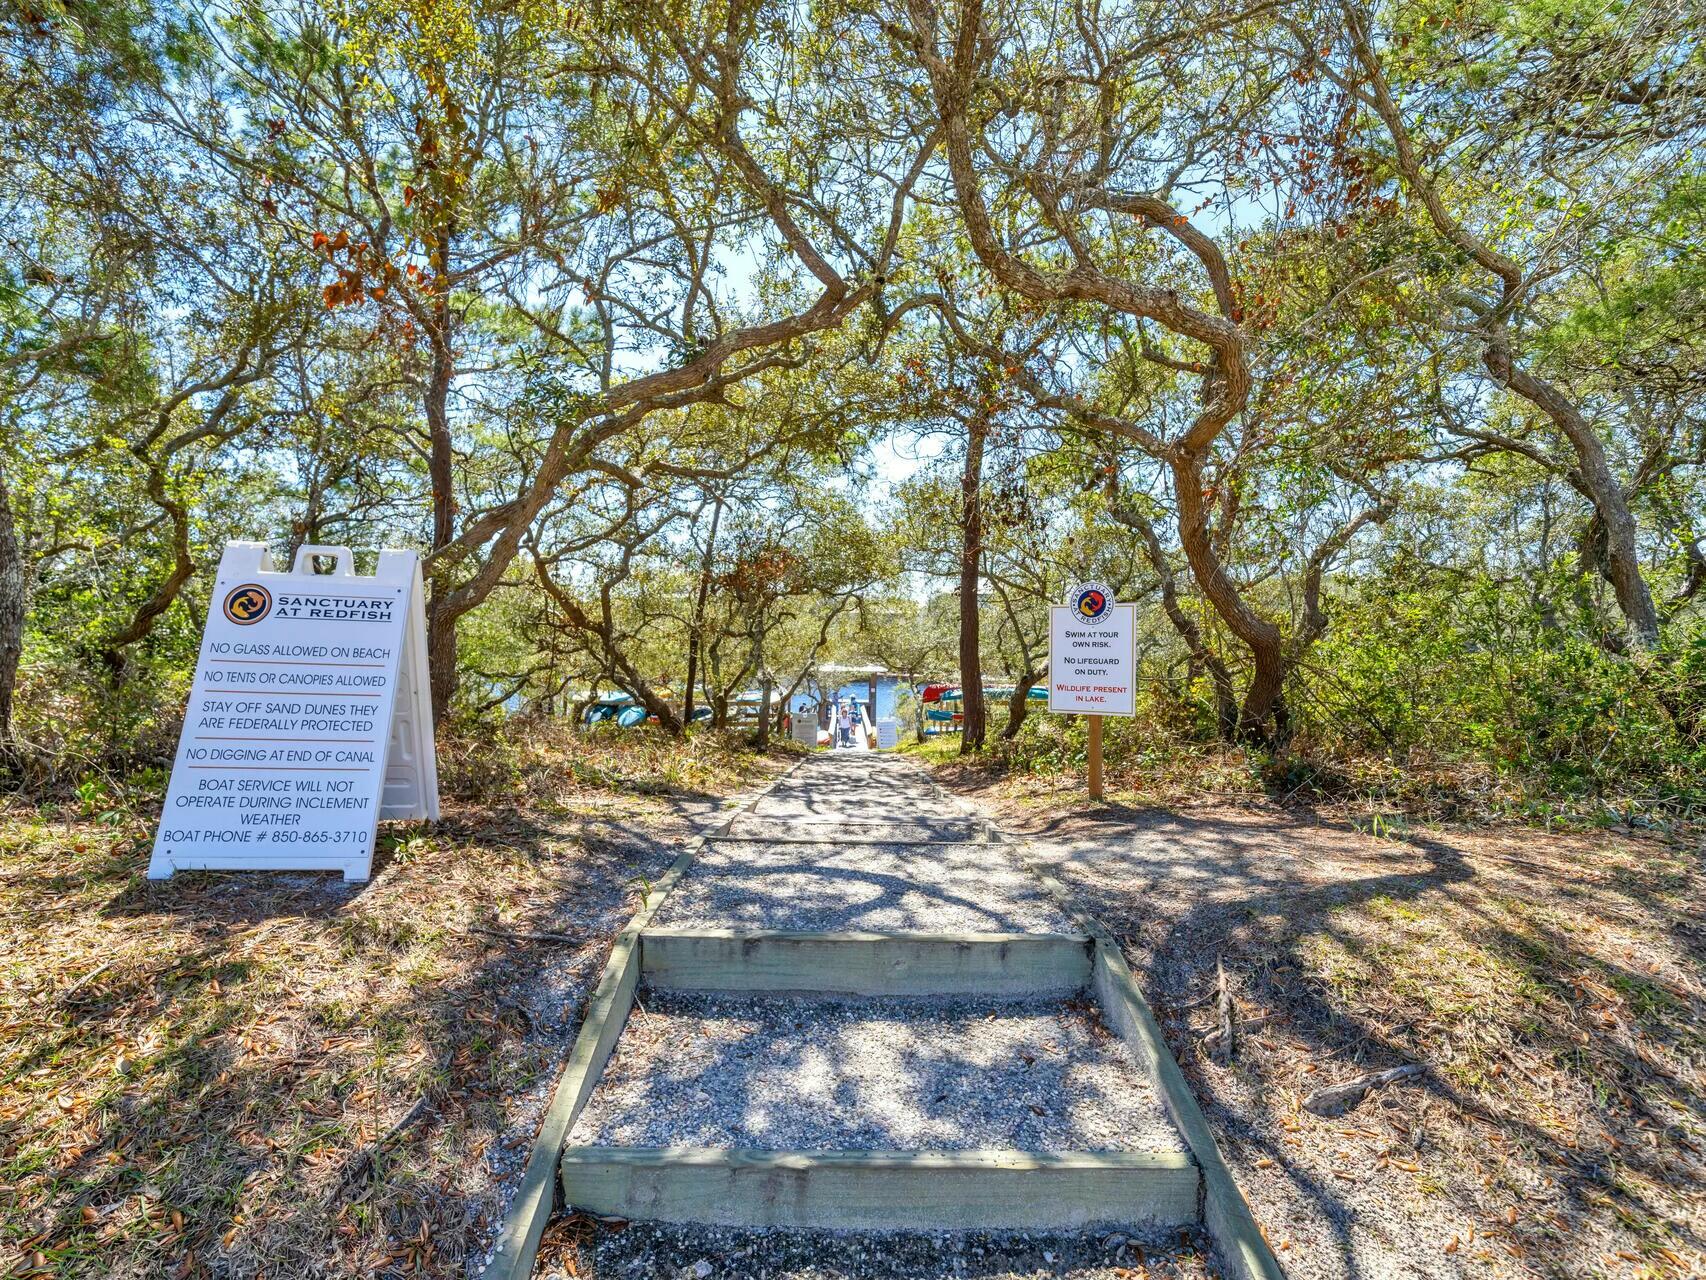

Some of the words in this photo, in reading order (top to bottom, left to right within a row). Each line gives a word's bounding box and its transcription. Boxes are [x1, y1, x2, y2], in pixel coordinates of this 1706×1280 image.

[1073, 585, 1112, 604] SANCTUARY
[278, 596, 395, 609] SANCTUARY
[276, 607, 301, 617] AT
[310, 608, 391, 620] REDFISH
[1073, 607, 1081, 617] AT
[1081, 607, 1112, 623] REDFISH
[210, 643, 230, 653] NO
[233, 644, 270, 655] GLASS
[272, 646, 328, 657] ALLOWED
[331, 647, 350, 657] ON
[352, 648, 390, 659] BEACH
[204, 671, 224, 682] NO
[226, 672, 256, 683] TENTS
[259, 673, 276, 684] OR
[279, 673, 333, 685] CANOPIES
[335, 675, 386, 686] ALLOWED
[1057, 684, 1090, 692] WILDLIFE
[202, 702, 232, 712] STAY
[236, 702, 261, 713] OFF
[265, 703, 301, 714] SAND
[304, 704, 347, 715] DUNES
[350, 705, 378, 716] THEY
[198, 718, 224, 729] ARE
[228, 718, 298, 730] FEDERALLY
[300, 720, 373, 732] PROTECTED
[186, 749, 207, 759] NO
[210, 749, 267, 761] DIGGING
[269, 750, 285, 761] AT
[287, 750, 312, 761] END
[315, 751, 333, 761] OF
[335, 752, 375, 762] CANAL
[198, 780, 234, 790] BOAT
[237, 780, 290, 792] SERVICE
[295, 780, 322, 792] WILL
[326, 781, 355, 792] NOT
[176, 796, 235, 807] OPERATE
[240, 797, 293, 808] DURING
[295, 797, 369, 808] INCLEMENT
[240, 814, 300, 825] WEATHER
[164, 831, 201, 842] BOAT
[204, 831, 251, 842] PHONE
[256, 831, 266, 842] #
[272, 831, 367, 843] 850-865-3710
